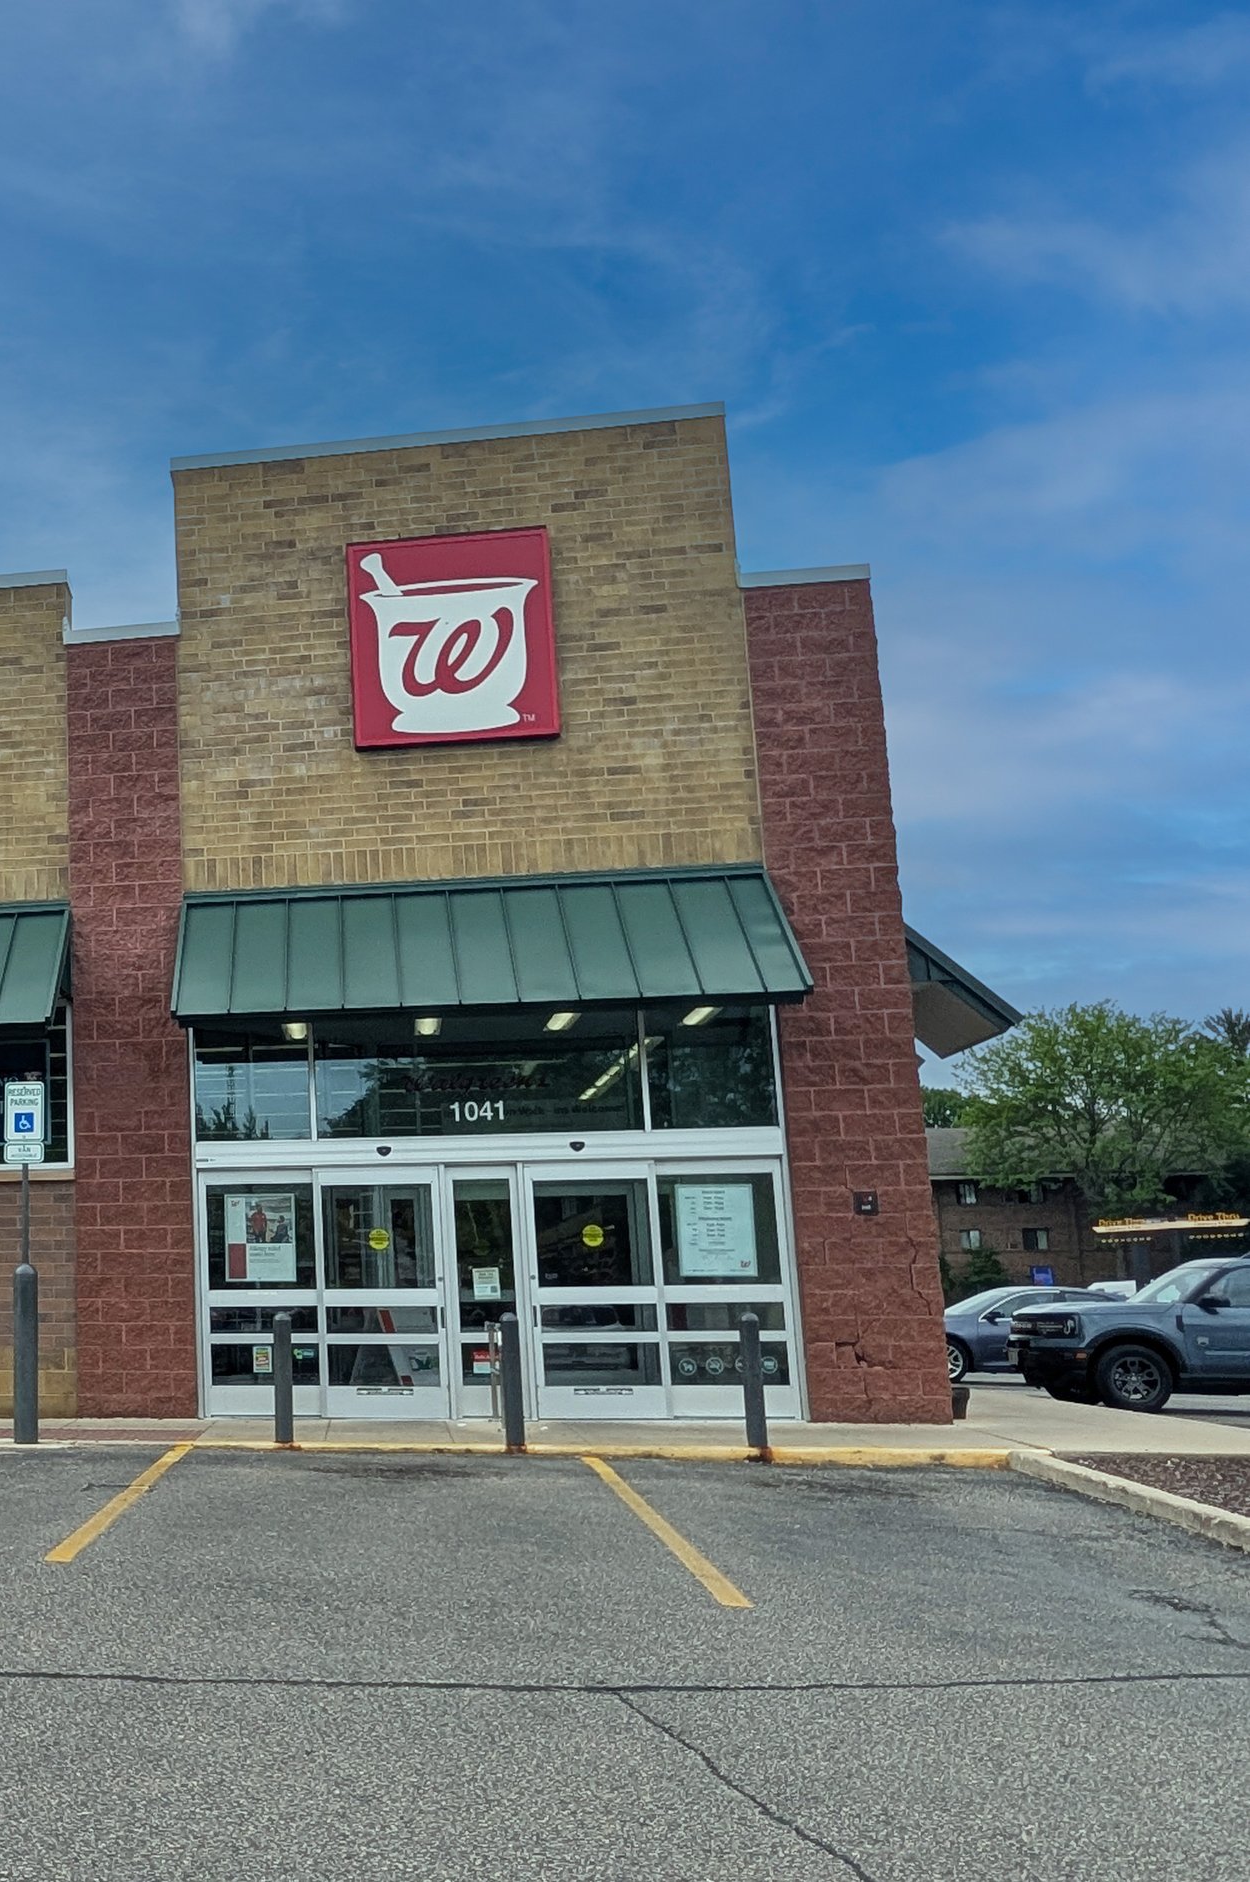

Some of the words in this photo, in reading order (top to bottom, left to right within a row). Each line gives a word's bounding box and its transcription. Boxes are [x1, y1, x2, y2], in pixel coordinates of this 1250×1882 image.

[522, 712, 535, 722] TM
[8, 1087, 41, 1096] RESERVED
[10, 1098, 39, 1107] PARKING
[449, 1100, 506, 1122] 1041
[1188, 1213, 1214, 1222] Drive
[1215, 1211, 1240, 1221] Thru
